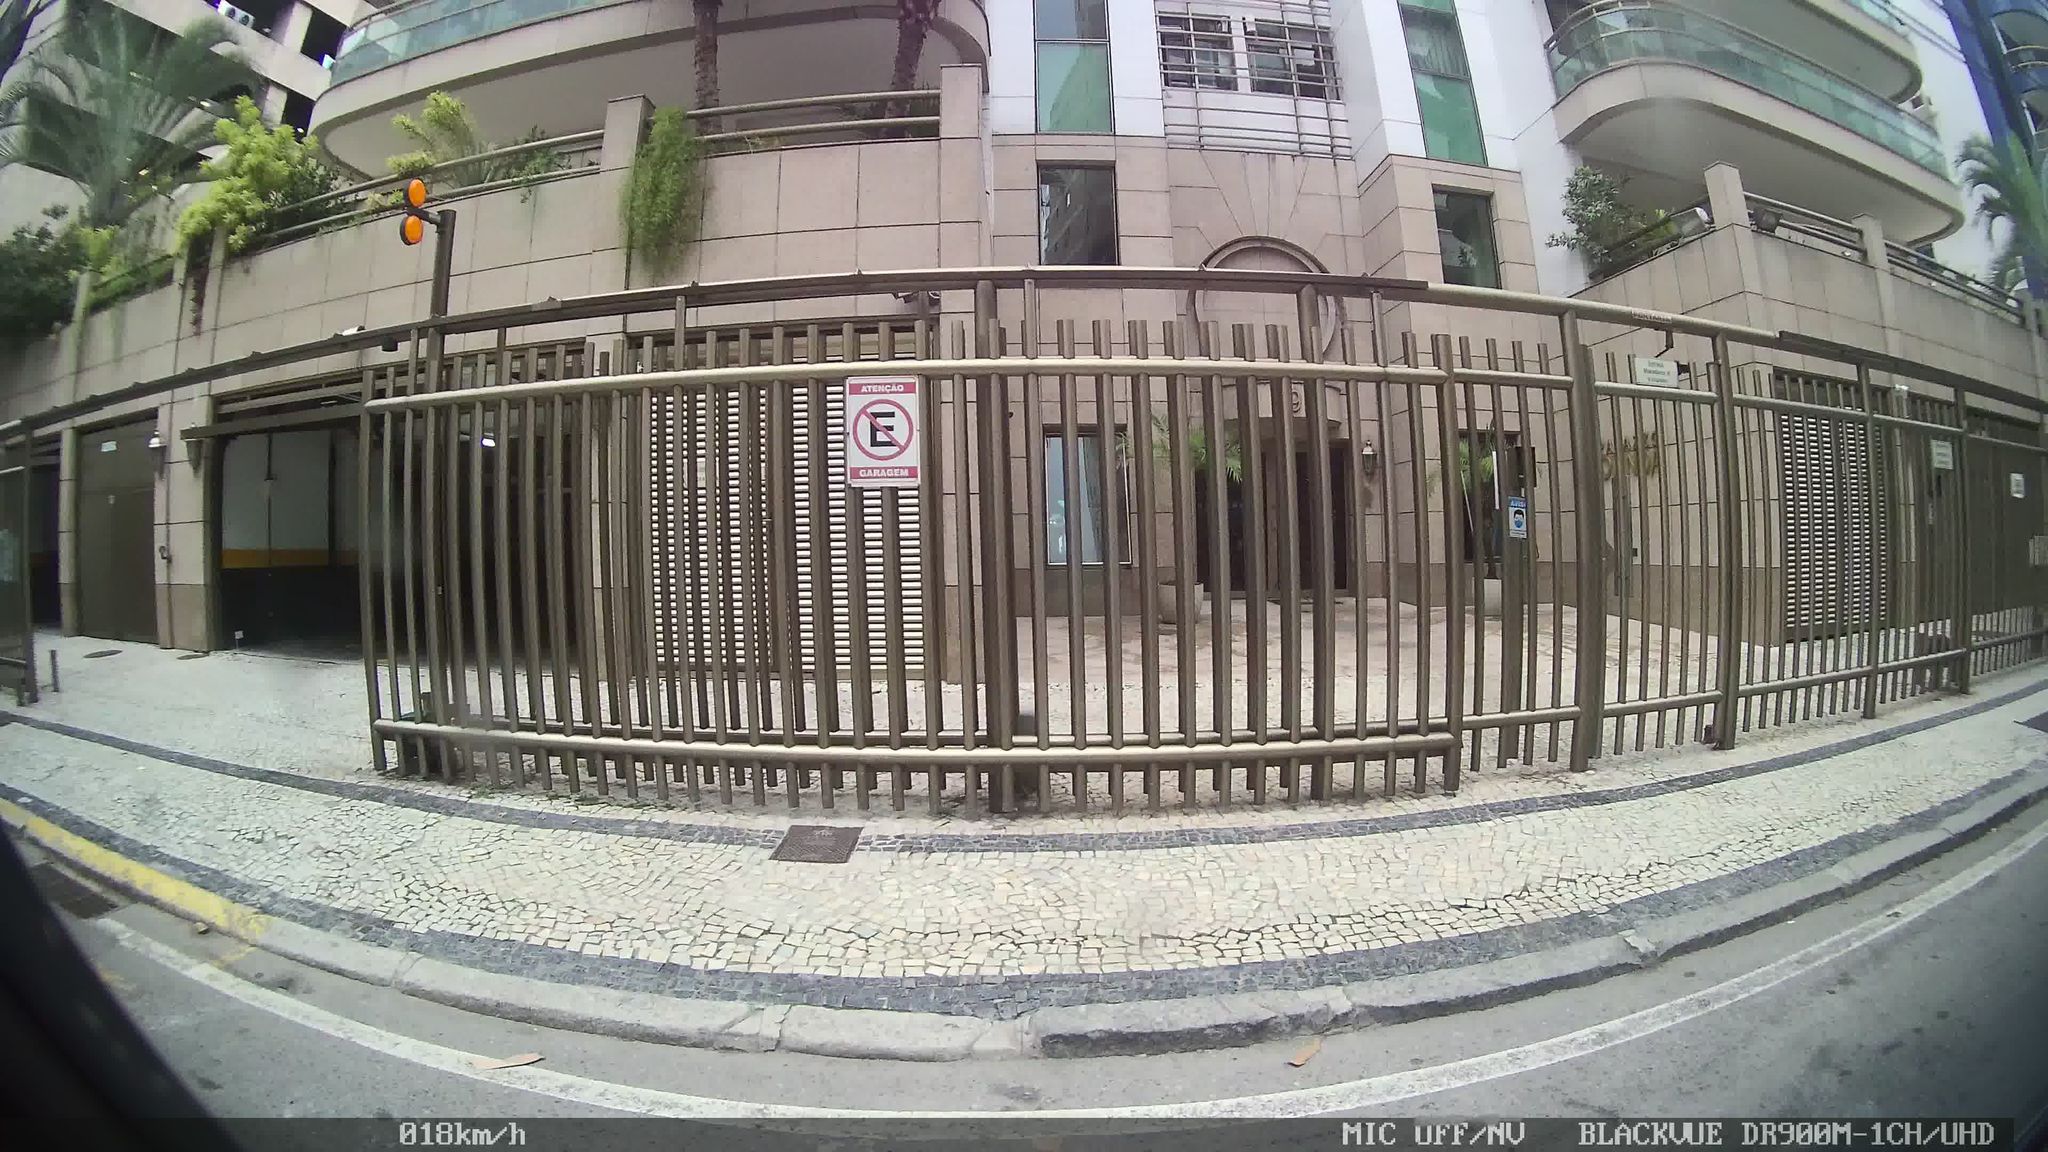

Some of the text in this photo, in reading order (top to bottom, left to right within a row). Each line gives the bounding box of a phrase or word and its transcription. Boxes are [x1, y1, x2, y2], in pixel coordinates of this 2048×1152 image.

[861, 384, 904, 393] ATENÇÃO
[870, 412, 897, 447] E
[859, 469, 909, 477] GARAGEM
